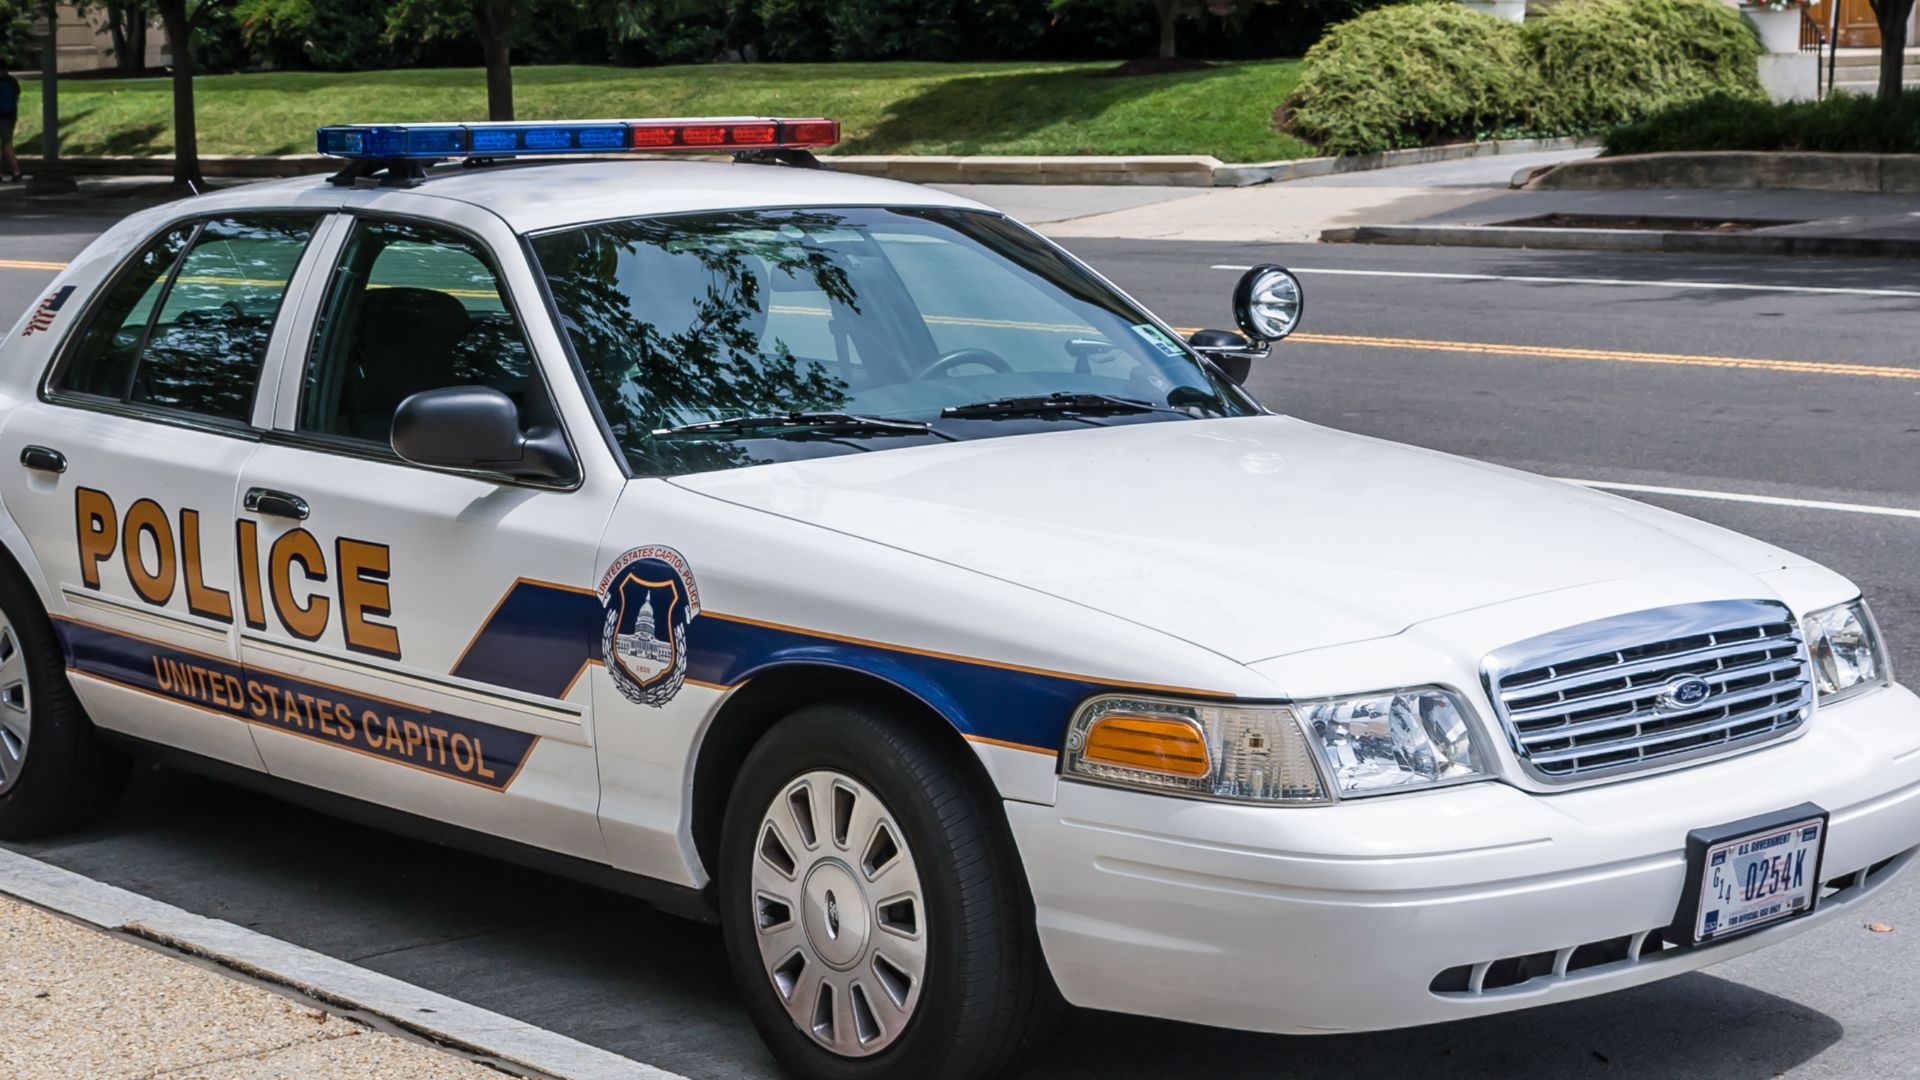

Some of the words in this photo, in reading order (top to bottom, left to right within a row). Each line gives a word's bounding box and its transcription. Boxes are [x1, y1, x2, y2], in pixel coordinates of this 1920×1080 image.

[75, 486, 401, 661] POLICE
[599, 561, 621, 597] UNITED
[623, 548, 653, 565] STATES
[655, 549, 683, 573] CAPITOL
[682, 570, 698, 609] POLICE
[152, 654, 244, 711] UNITED
[249, 683, 355, 741] STATES
[362, 710, 495, 779] CAPITOL
[1751, 832, 1791, 852] GOVERNMENT
[1745, 848, 1806, 901] 0254K
